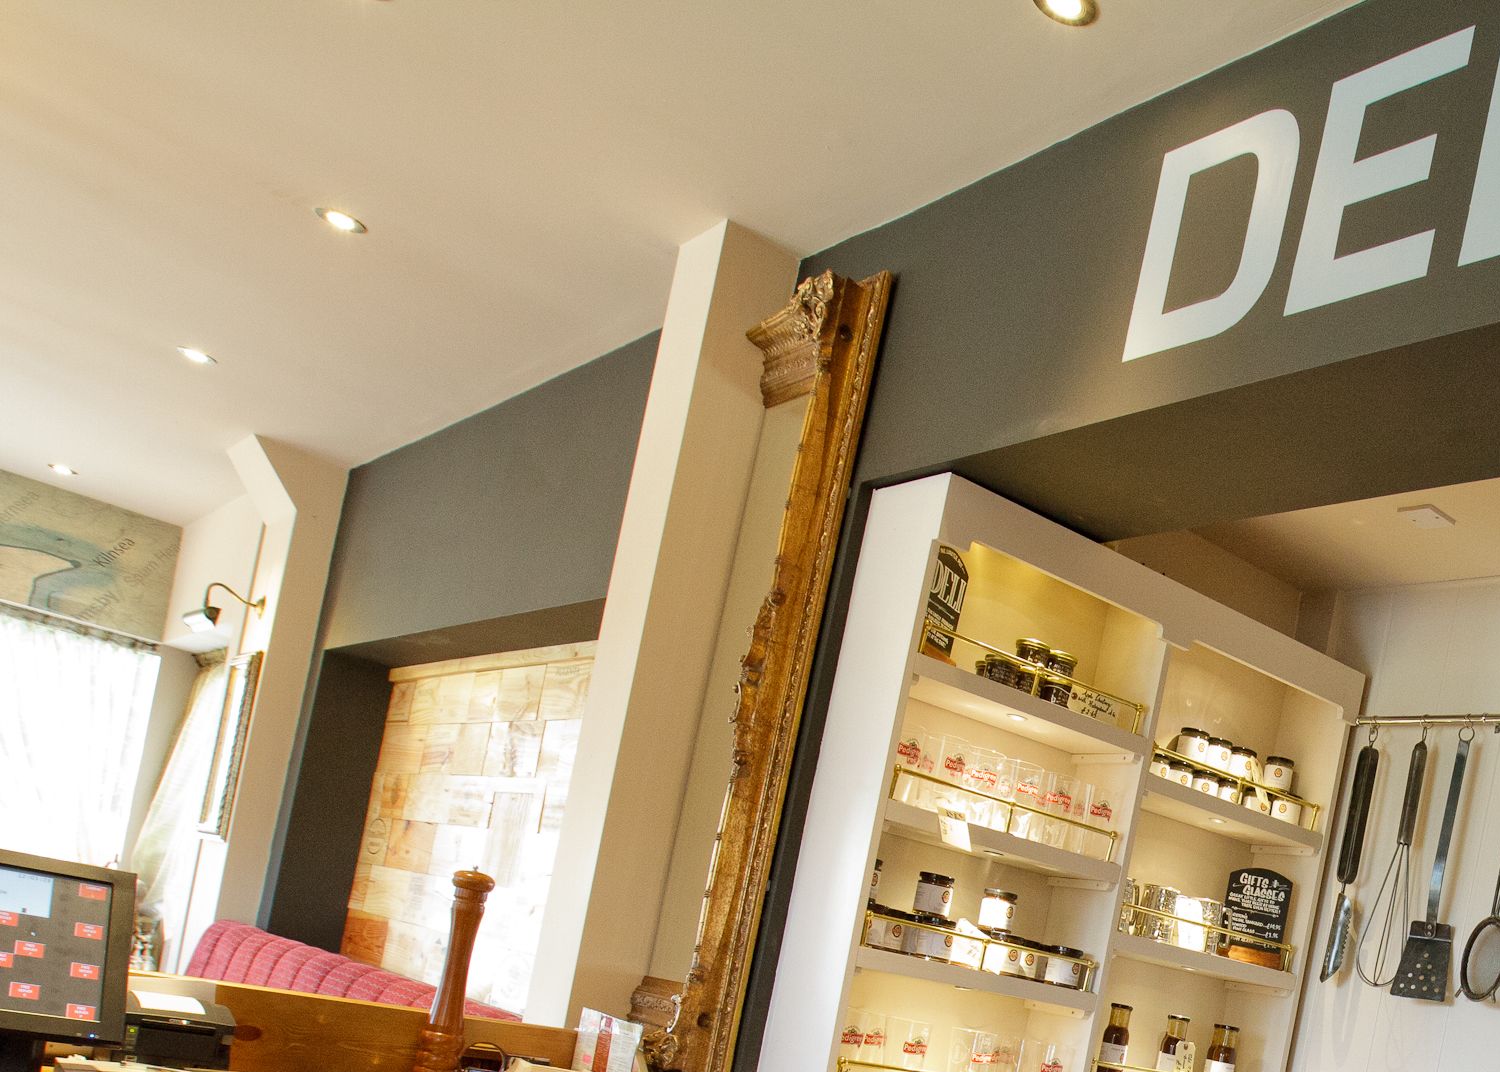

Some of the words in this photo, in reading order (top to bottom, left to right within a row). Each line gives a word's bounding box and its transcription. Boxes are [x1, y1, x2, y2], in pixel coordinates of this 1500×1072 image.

[930, 559, 967, 614] DELI
[1240, 873, 1269, 889] GIFTS
[1242, 885, 1285, 901] GLASSES
